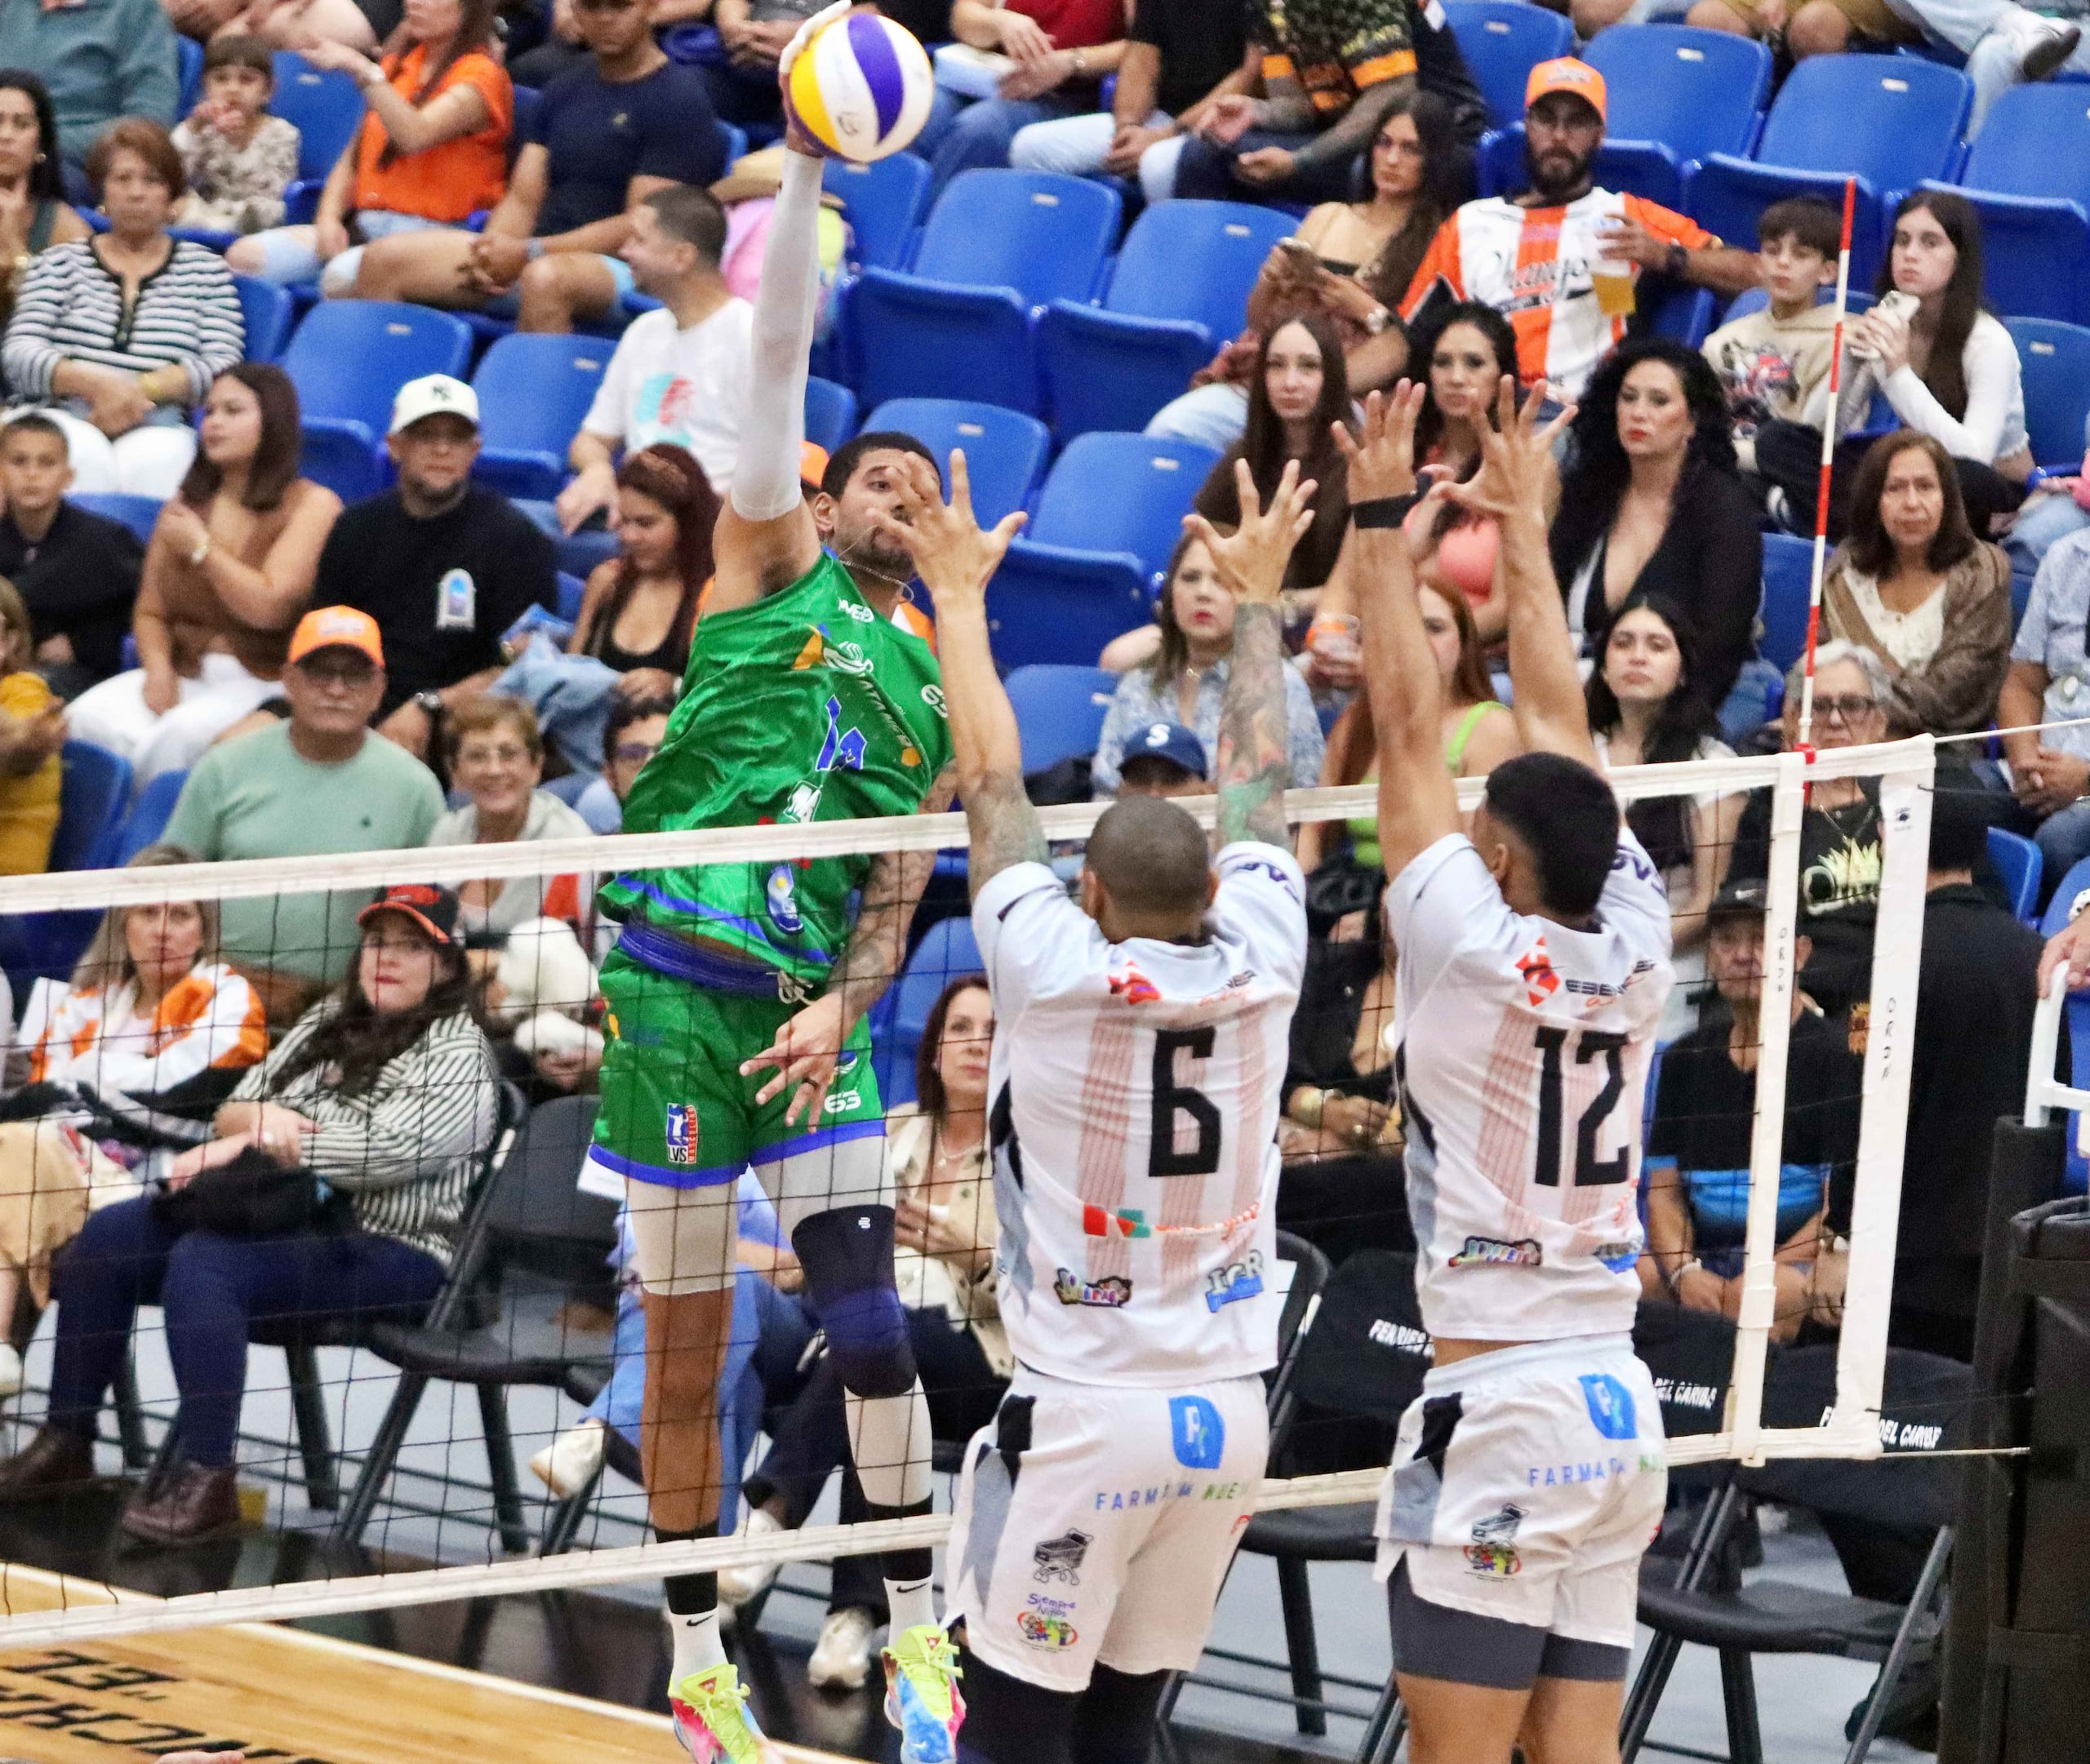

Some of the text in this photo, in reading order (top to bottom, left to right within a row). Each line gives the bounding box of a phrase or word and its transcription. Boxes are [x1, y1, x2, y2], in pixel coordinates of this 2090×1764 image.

[1145, 723, 1171, 747] S
[1148, 1025, 1222, 1177] 6
[1534, 1025, 1630, 1187] 12
[668, 1146, 687, 1162] LVS
